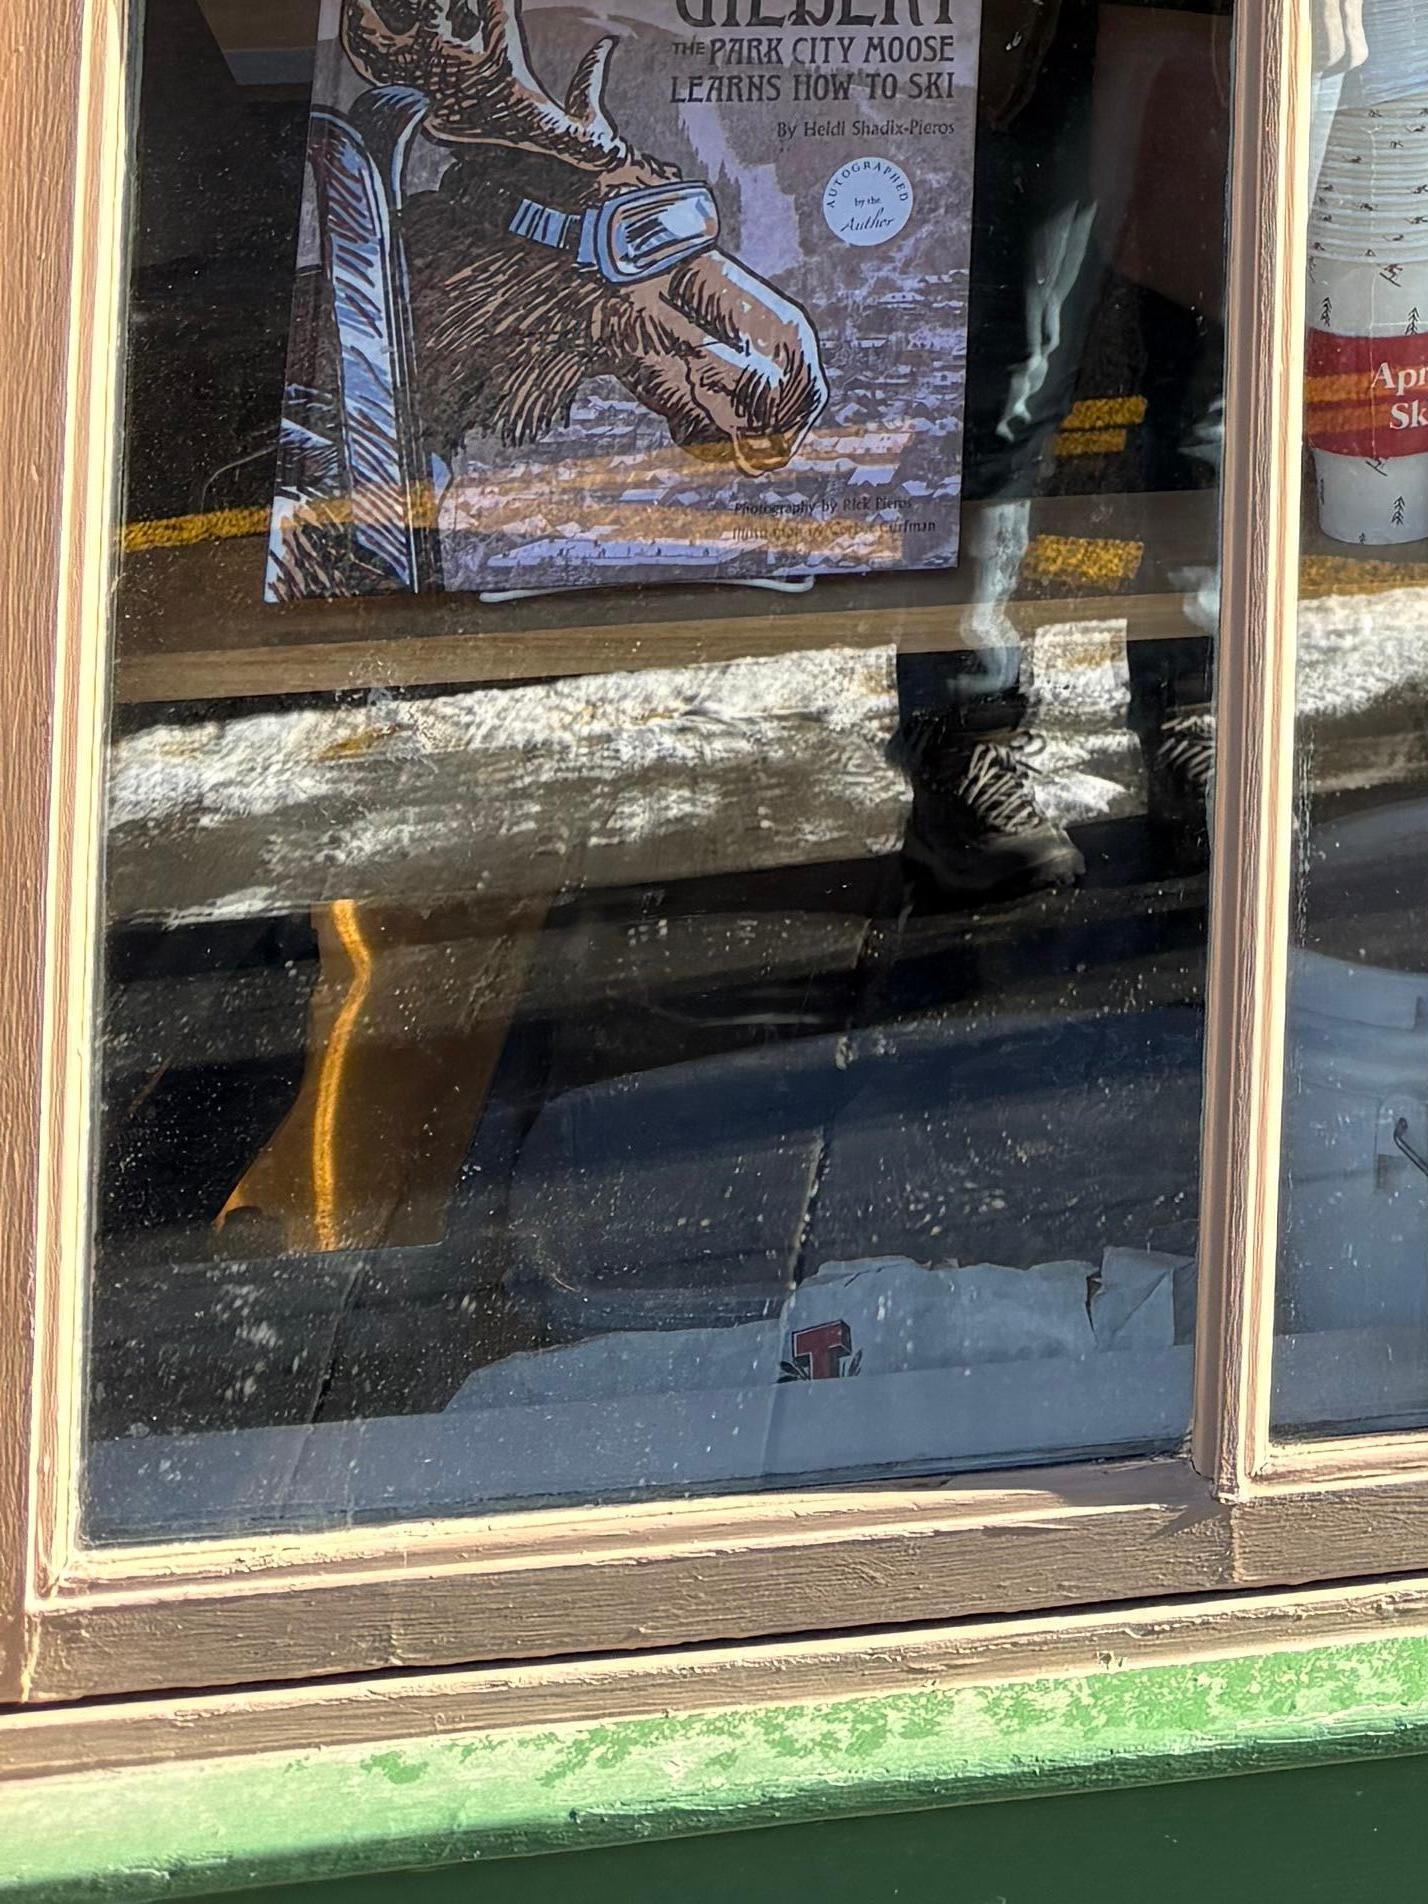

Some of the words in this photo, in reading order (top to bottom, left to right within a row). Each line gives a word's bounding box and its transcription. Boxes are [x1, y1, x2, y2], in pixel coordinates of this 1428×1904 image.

[671, 42, 706, 56] THE
[709, 37, 784, 66] PARK
[792, 36, 855, 64] CITY
[863, 35, 955, 63] MOOSE
[669, 74, 782, 104] LEARNS
[793, 72, 851, 101] HOW
[864, 72, 898, 100] TO
[908, 72, 955, 100] SKI
[777, 121, 797, 140] By
[803, 119, 845, 138] Heidi
[852, 118, 955, 137] Shadix-Pieros
[826, 161, 909, 209] AUTOGRAPHED
[854, 197, 865, 208] by
[867, 195, 881, 205] the
[840, 206, 895, 232] Author
[734, 500, 816, 517] Photography
[822, 498, 838, 513] by
[843, 496, 871, 511] Rick
[876, 495, 912, 510] Pieros
